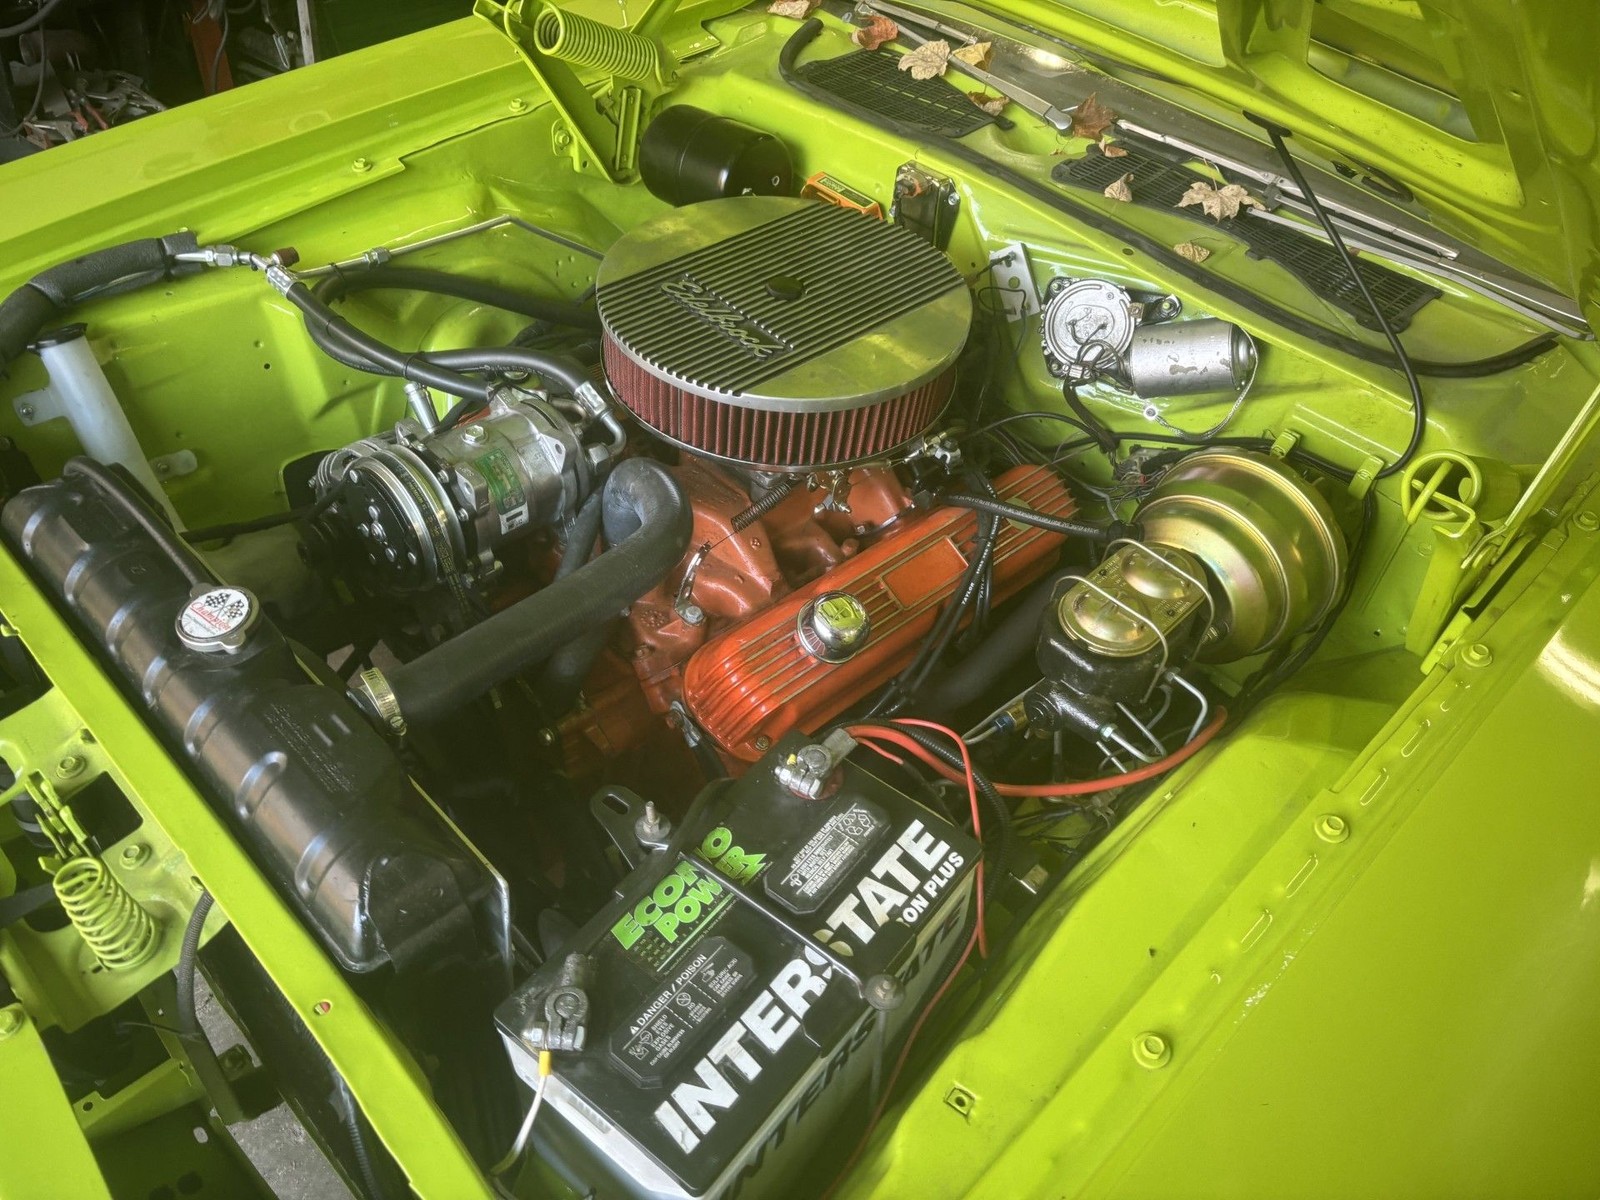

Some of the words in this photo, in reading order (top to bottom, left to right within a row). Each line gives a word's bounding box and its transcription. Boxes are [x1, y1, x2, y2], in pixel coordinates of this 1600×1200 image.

[661, 280, 784, 358] Edelbrock
[961, 582, 975, 605] TAYLOR
[923, 852, 965, 898] PLUS
[635, 989, 673, 1026] DANGER
[674, 952, 707, 985] POISON
